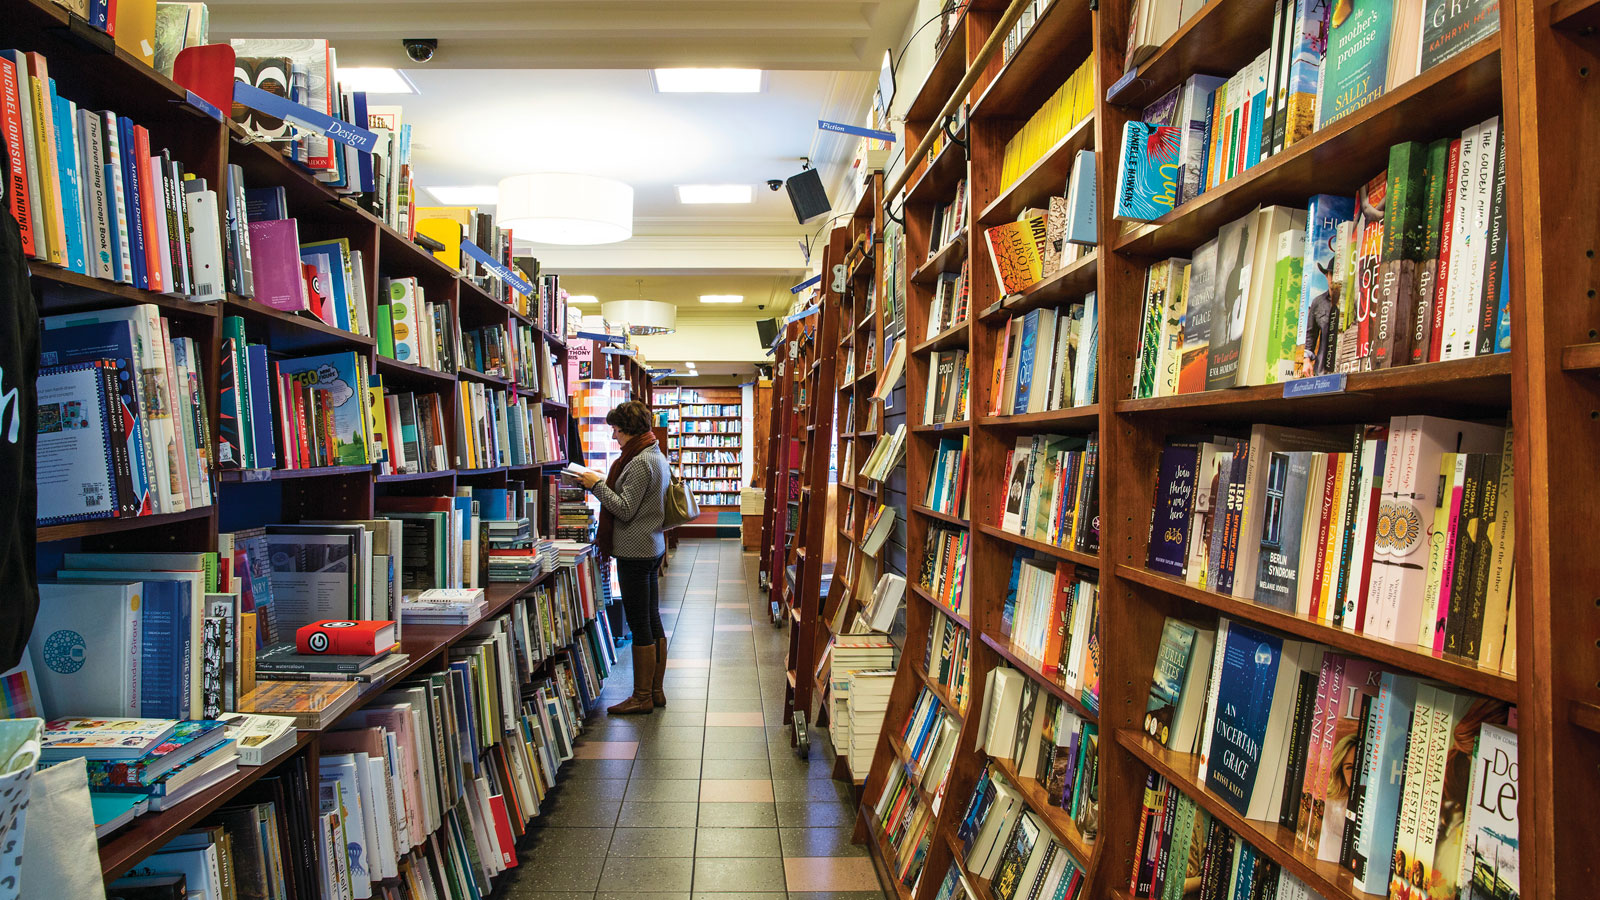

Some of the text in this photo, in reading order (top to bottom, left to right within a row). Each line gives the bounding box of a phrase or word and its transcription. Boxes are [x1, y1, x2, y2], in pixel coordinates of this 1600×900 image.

[1338, 10, 1378, 49] mother's
[1354, 8, 1364, 21] the
[1337, 29, 1376, 70] promise
[1429, 20, 1470, 52] KATHRYN
[1335, 76, 1371, 112] SALLY
[326, 120, 367, 146] Design
[822, 122, 845, 132] Fiction
[3, 62, 28, 232] MICHAEL JOHNSON BRANDING
[92, 138, 101, 190] Advertising
[1478, 129, 1492, 195] THE GOLDEN
[1124, 128, 1140, 209] DANIELLE HAWKINS
[1448, 147, 1458, 184] Kathleen
[1460, 137, 1473, 202] THE GOLDEN
[96, 191, 104, 226] Concept
[163, 176, 171, 210] GRAPHIC
[1446, 188, 1454, 214] James
[135, 203, 144, 250] Designers
[1365, 219, 1384, 236] THE
[1442, 221, 1450, 254] INLAWS
[1009, 229, 1034, 283] ABBOTT
[1024, 242, 1036, 264] JANE
[1483, 174, 1506, 331] Place London MAGGIE JOEL
[494, 266, 528, 292] Architecture
[1192, 310, 1212, 327] PLACE
[1378, 271, 1396, 340] the fence
[1415, 271, 1430, 342] the fence
[1435, 286, 1444, 329] OUTLAWS
[938, 362, 954, 374] SPOILS
[1326, 344, 1334, 368] How
[136, 370, 144, 399] ART
[1292, 378, 1330, 393] Australian Fiction
[139, 401, 150, 439] DECO
[144, 441, 157, 493] POSTER
[1336, 460, 1344, 481] TONI
[1352, 433, 1360, 476] MACHINES
[1402, 447, 1416, 489] Starlings
[1170, 481, 1192, 499] Harley
[1227, 483, 1236, 510] LEAP
[1235, 484, 1244, 511] LEAP
[1323, 468, 1334, 497] Nine
[1464, 478, 1472, 518] KENEALLY
[1170, 508, 1184, 520] here
[1172, 498, 1185, 507] was
[1322, 495, 1331, 521] Days
[1331, 482, 1340, 524] JORDAN
[1345, 495, 1354, 527] FEELING
[1482, 480, 1492, 522] KENEALLY
[1488, 484, 1496, 517] THOMAS
[1223, 513, 1232, 549] MYFANWY
[1231, 514, 1240, 549] MYFANWY
[1326, 524, 1336, 558] FALL
[1500, 510, 1509, 542] Crimes
[1269, 552, 1288, 566] BERLIN
[1340, 530, 1349, 566] MIREILLE
[1500, 544, 1504, 552] of
[1259, 581, 1289, 594] MELANIE JOOSTEN
[1268, 564, 1296, 580] SYNDROME
[1322, 560, 1331, 591] GIRL
[1494, 566, 1502, 593] Father
[1425, 584, 1433, 604] Kelly
[1160, 646, 1186, 668] BURIAL
[1160, 659, 1180, 681] RITES
[130, 656, 138, 710] Alexander
[1320, 660, 1330, 690] Karly
[1224, 702, 1236, 718] AN
[1294, 684, 1304, 720] PORTABLE
[1322, 664, 1342, 751] Karly LANE
[1377, 697, 1386, 736] HEALING
[1310, 693, 1327, 746] LANE
[1216, 718, 1259, 763] UNCERTAIN
[1288, 720, 1298, 766] CURIOSITIES
[1371, 740, 1380, 773] PARTY
[1223, 750, 1249, 781] GRACE
[1400, 704, 1422, 832] HER MOTHER'S SECRET
[1406, 706, 1430, 836] NATASHA LESTER
[1418, 711, 1441, 840] HER MOTHER'S SECRET
[1424, 712, 1449, 846] NATASHA LESTER
[1136, 822, 1144, 857] MARMALADE
